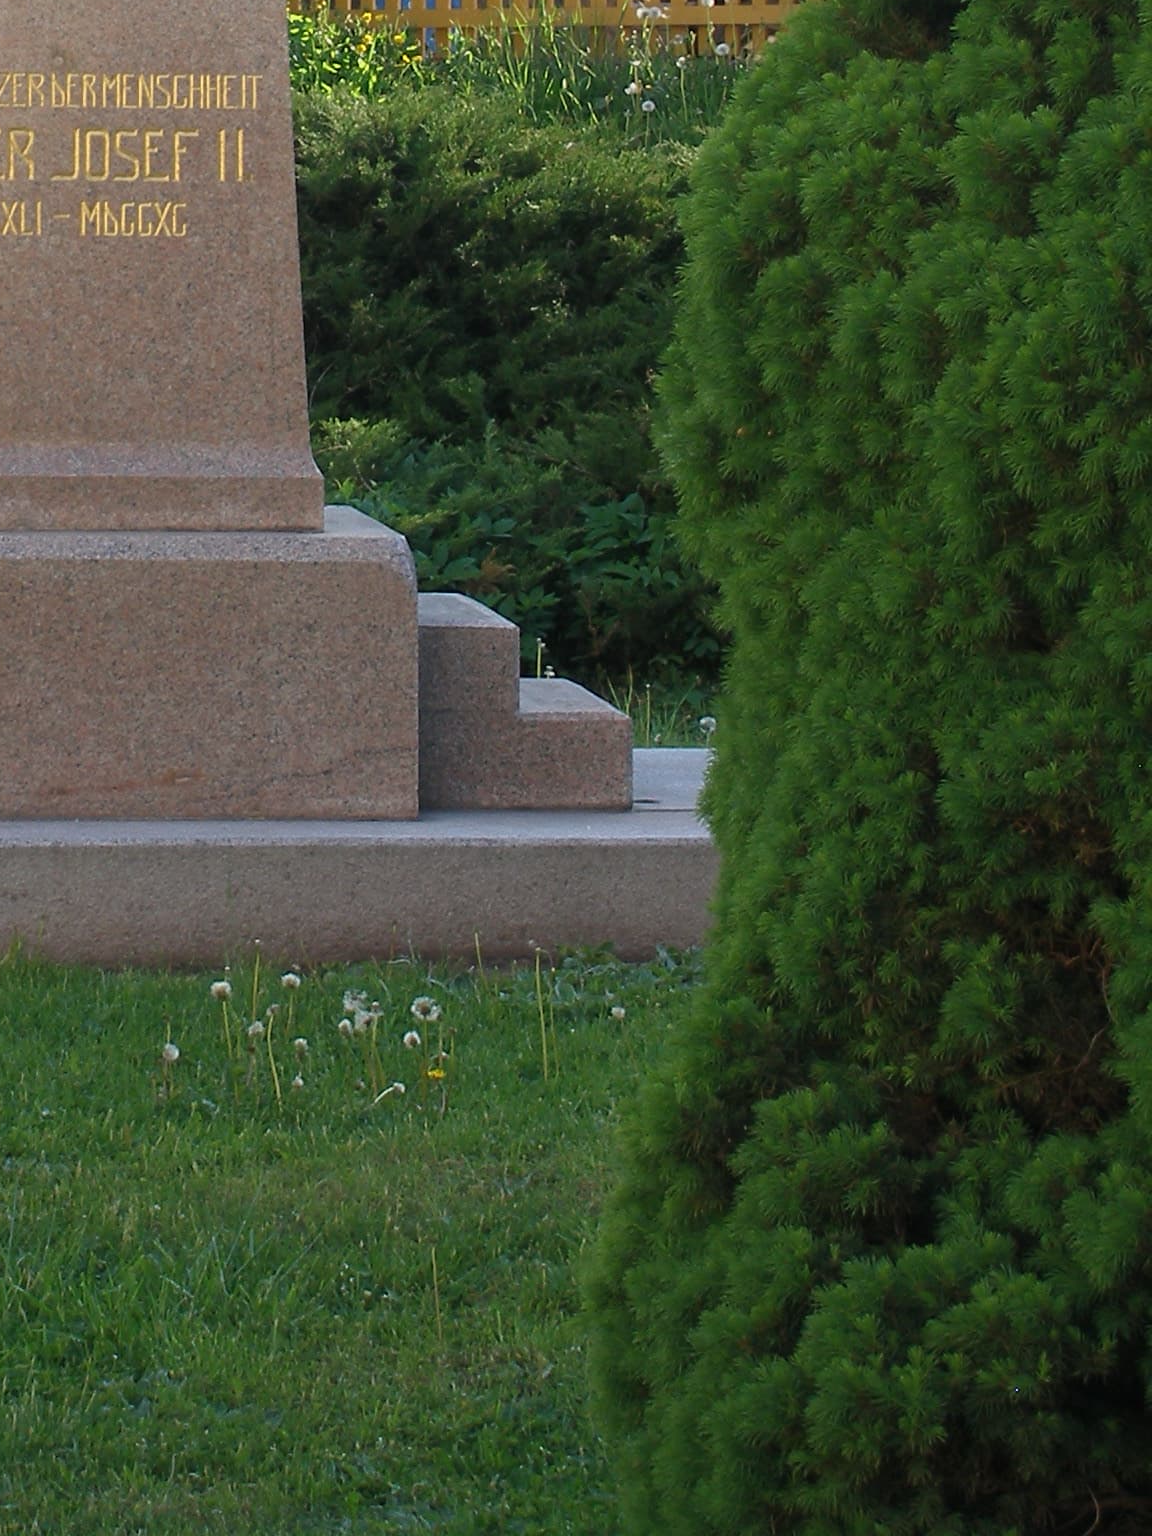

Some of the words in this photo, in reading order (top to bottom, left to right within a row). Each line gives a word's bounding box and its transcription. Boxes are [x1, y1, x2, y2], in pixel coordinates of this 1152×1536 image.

[51, 73, 97, 109] DER
[102, 74, 263, 110] MENSCHHEIT
[50, 128, 200, 183] JOSEF
